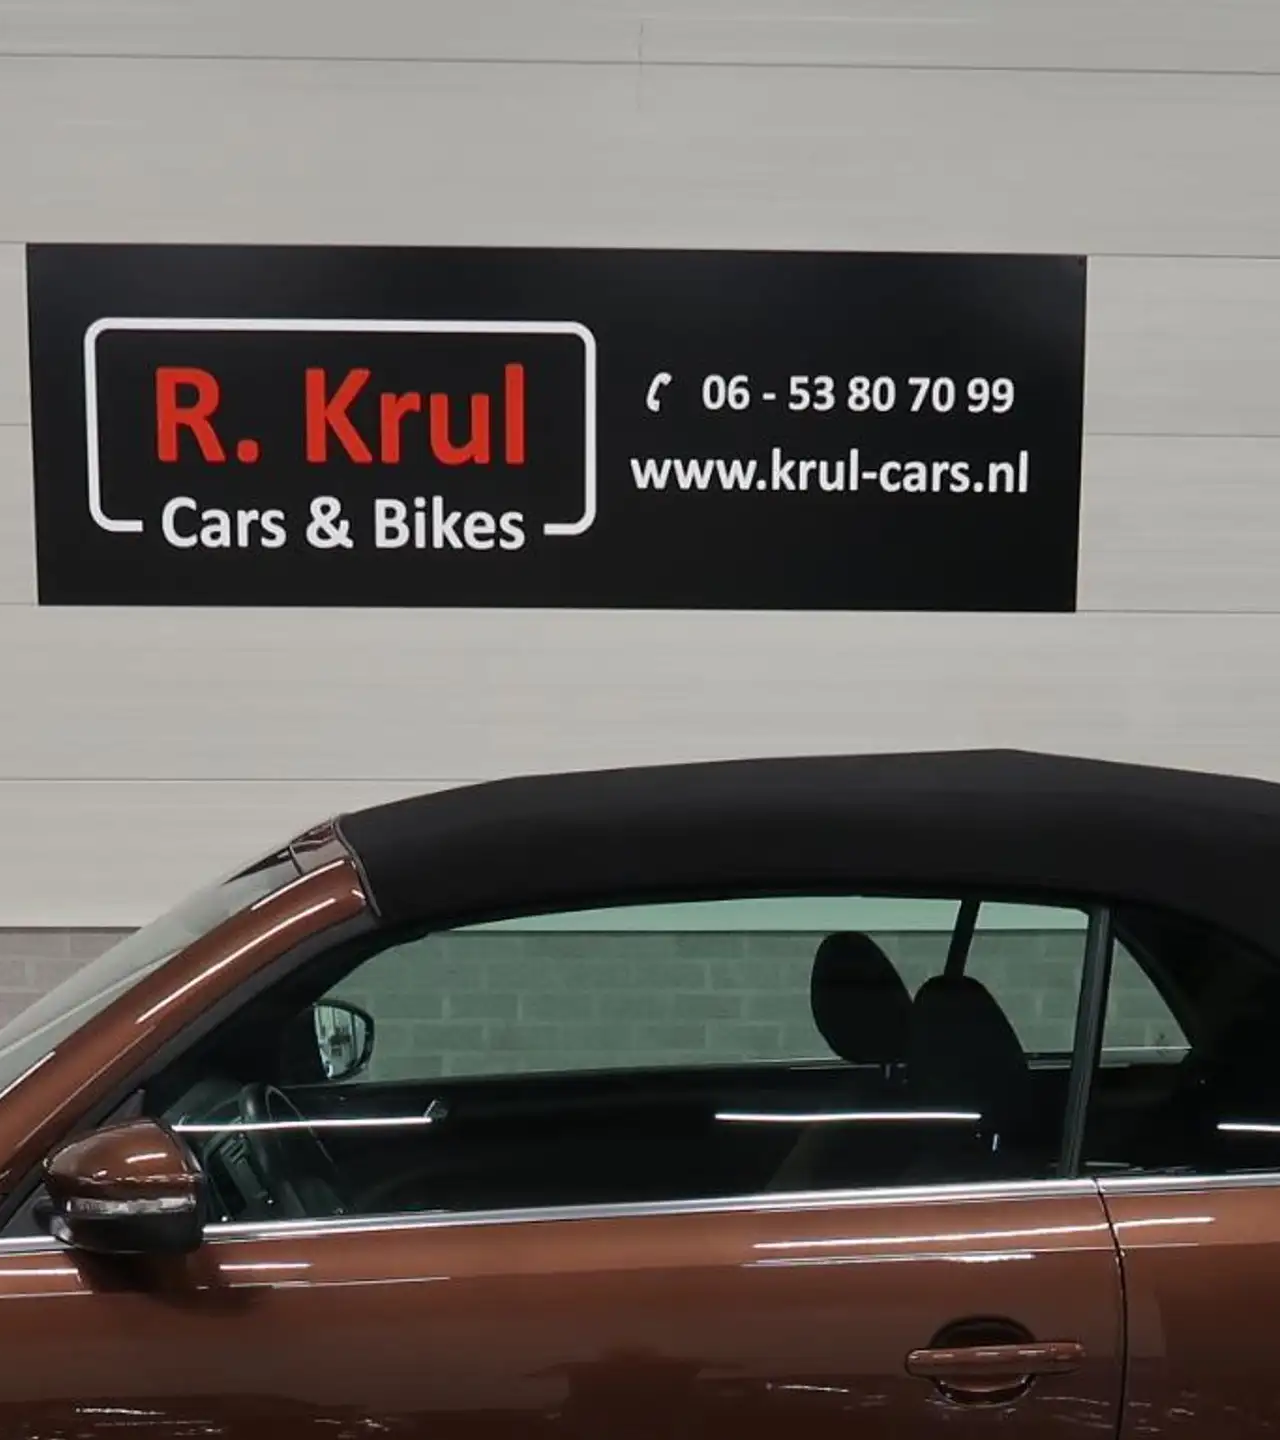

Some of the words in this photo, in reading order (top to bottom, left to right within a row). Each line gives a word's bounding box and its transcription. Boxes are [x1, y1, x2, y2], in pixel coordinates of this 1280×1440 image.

[156, 367, 259, 464] R.
[305, 363, 525, 466] Krul
[702, 374, 750, 411] 06
[788, 375, 835, 412] 53
[847, 375, 896, 413] 80
[908, 376, 956, 414] 70
[967, 377, 1015, 415] 99
[630, 447, 1029, 493] www.krul-cars.nl
[161, 496, 287, 548] Cars
[306, 495, 354, 549] &
[374, 495, 525, 550] Bikes
